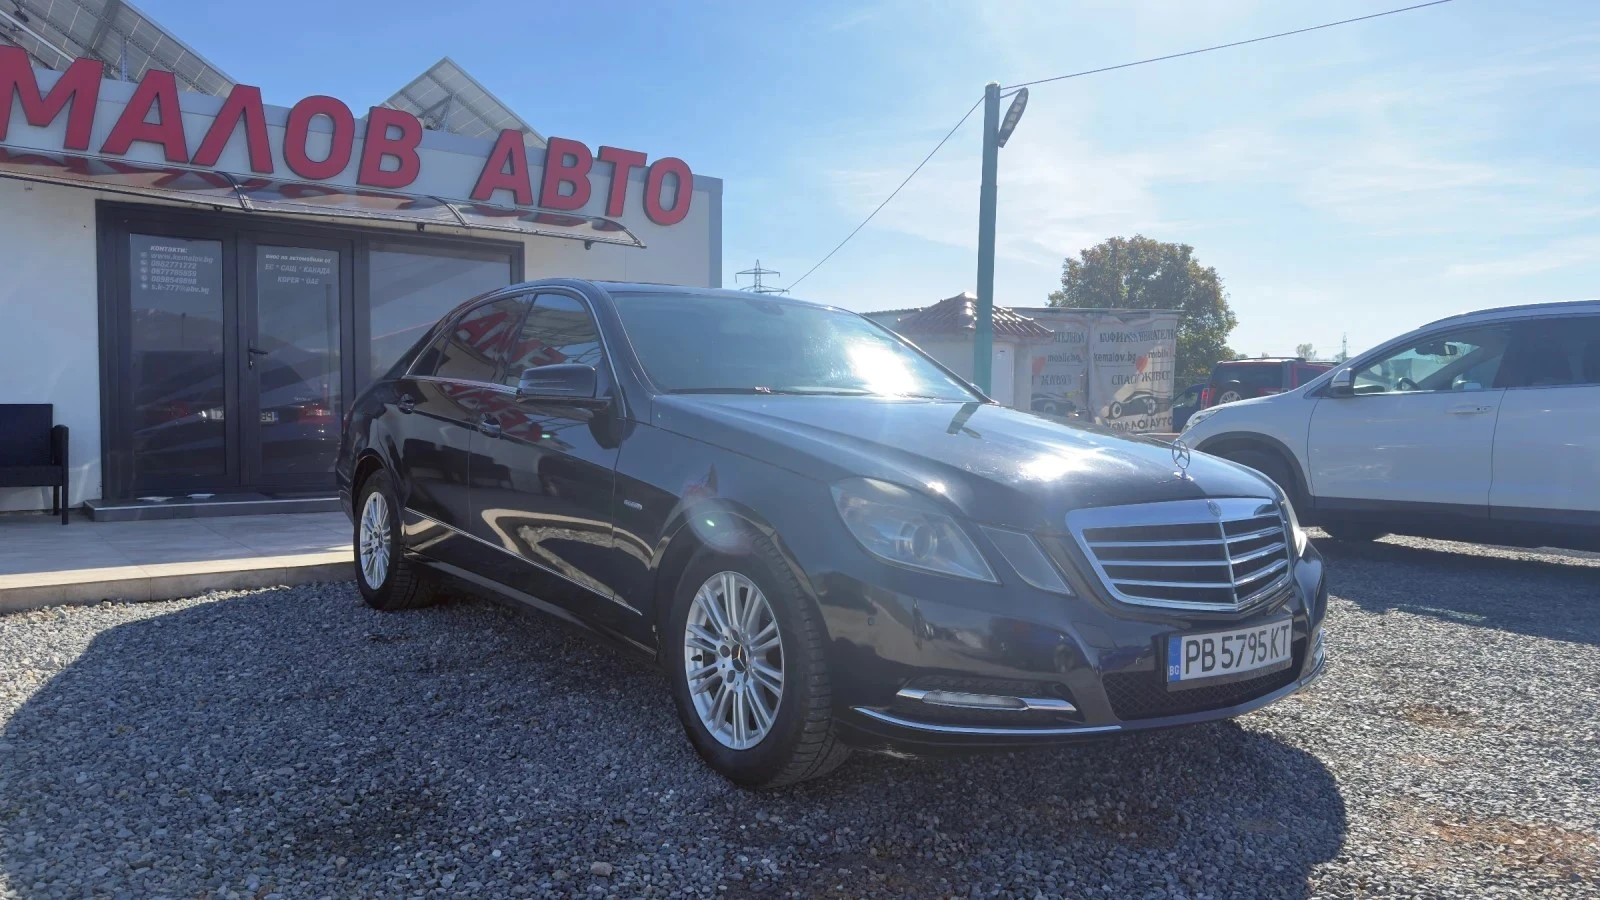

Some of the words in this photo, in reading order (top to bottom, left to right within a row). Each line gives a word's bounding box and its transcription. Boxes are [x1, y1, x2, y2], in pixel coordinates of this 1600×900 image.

[0, 45, 423, 188] МАЛОВ
[472, 129, 693, 225] АВТО
[1093, 351, 1137, 364] kemalov.bg
[1185, 638, 1216, 674] PB
[1221, 630, 1268, 669] 5795
[1270, 624, 1290, 660] KT
[1169, 665, 1180, 676] BG
